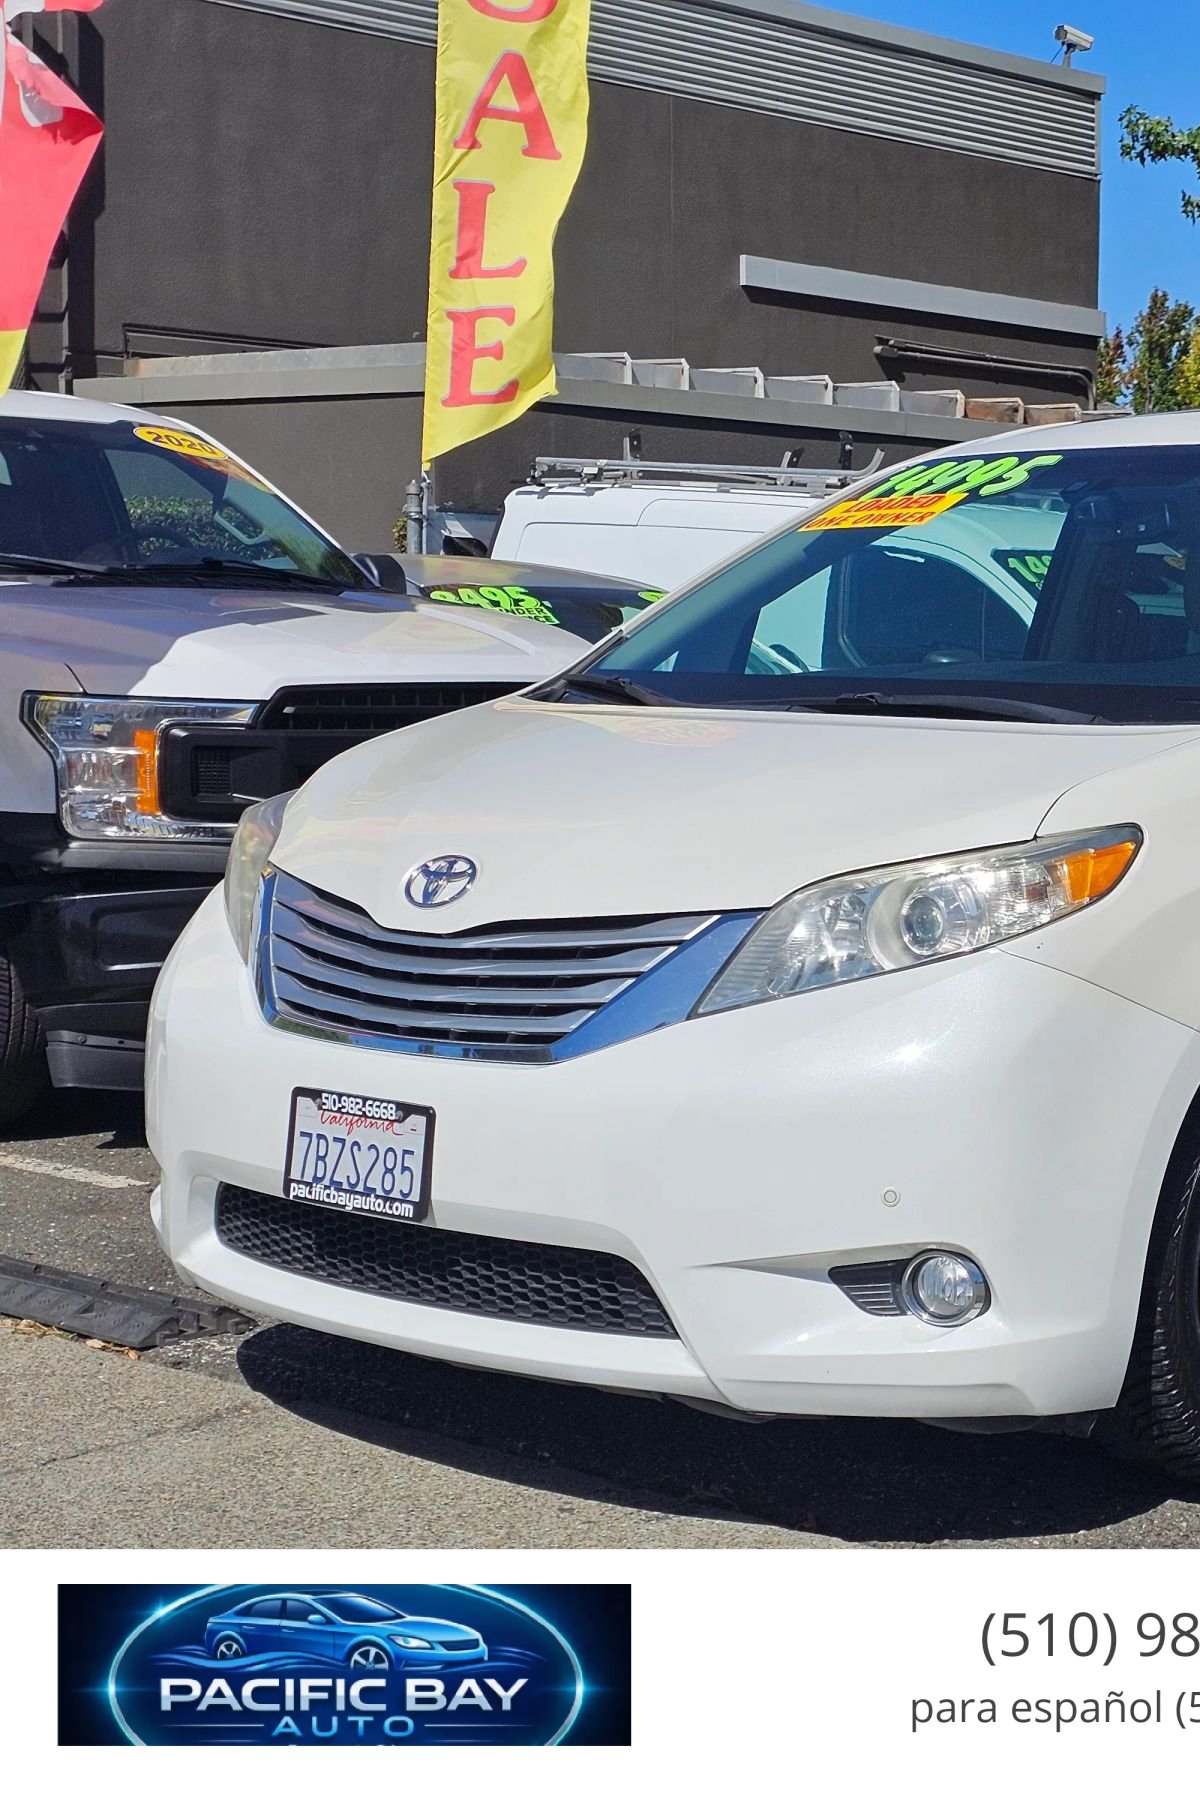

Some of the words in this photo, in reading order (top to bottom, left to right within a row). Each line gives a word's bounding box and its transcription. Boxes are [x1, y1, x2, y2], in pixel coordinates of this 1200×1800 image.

[146, 431, 217, 455] 2020
[858, 455, 1064, 500] 14995
[843, 494, 946, 514] LOADED
[805, 515, 852, 530] ONE
[851, 511, 937, 526] OWNER
[499, 607, 547, 616] NDER
[321, 1092, 397, 1120] 510-982-6668
[299, 1130, 415, 1199] 7BZS285
[289, 1182, 414, 1218] pacificbayauto.com
